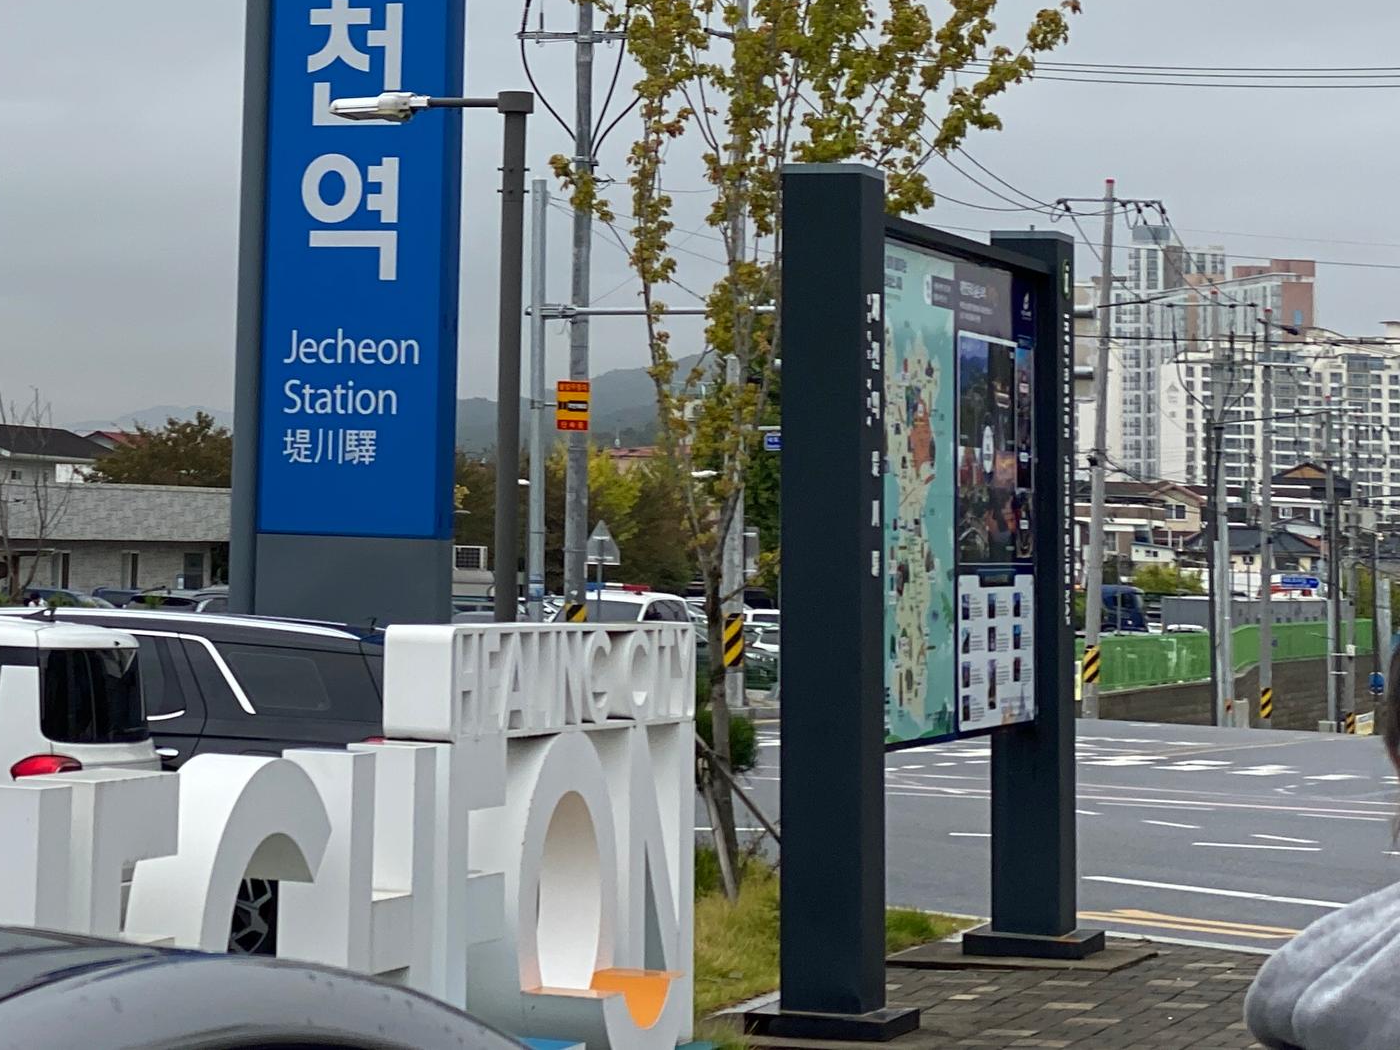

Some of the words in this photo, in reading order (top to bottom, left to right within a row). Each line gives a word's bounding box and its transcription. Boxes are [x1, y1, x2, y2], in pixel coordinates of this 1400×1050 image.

[283, 328, 420, 365] Jecheon
[283, 379, 398, 415] Station
[282, 428, 377, 465] 堤川驛
[456, 629, 612, 736] HEALING
[628, 623, 693, 720] CITY
